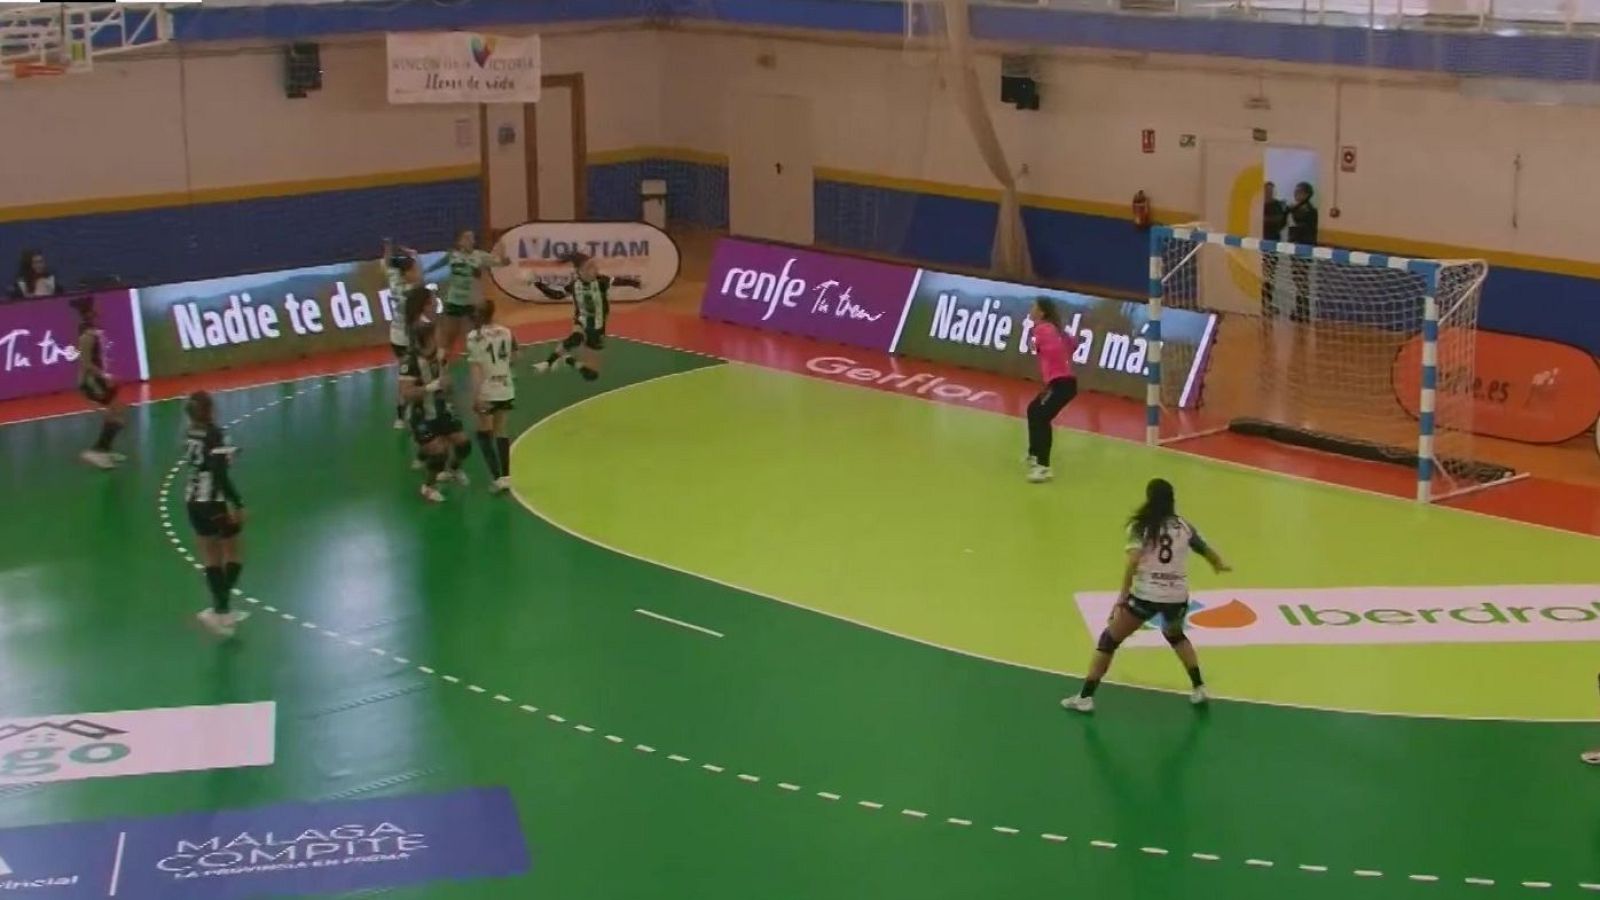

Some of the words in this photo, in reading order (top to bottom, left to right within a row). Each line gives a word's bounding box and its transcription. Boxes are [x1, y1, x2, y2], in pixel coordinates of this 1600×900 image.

[720, 257, 806, 321] renfe
[812, 279, 840, 314] Tu
[172, 292, 281, 351] Nadie
[284, 292, 324, 335] te
[330, 281, 373, 330] da
[929, 292, 1012, 351] Nadie
[1098, 322, 1164, 377] má
[0, 328, 31, 371] Tu
[486, 338, 508, 364] 14
[805, 356, 998, 402] Gerflor
[1158, 533, 1173, 564] 8
[157, 832, 430, 871] COMPITE
